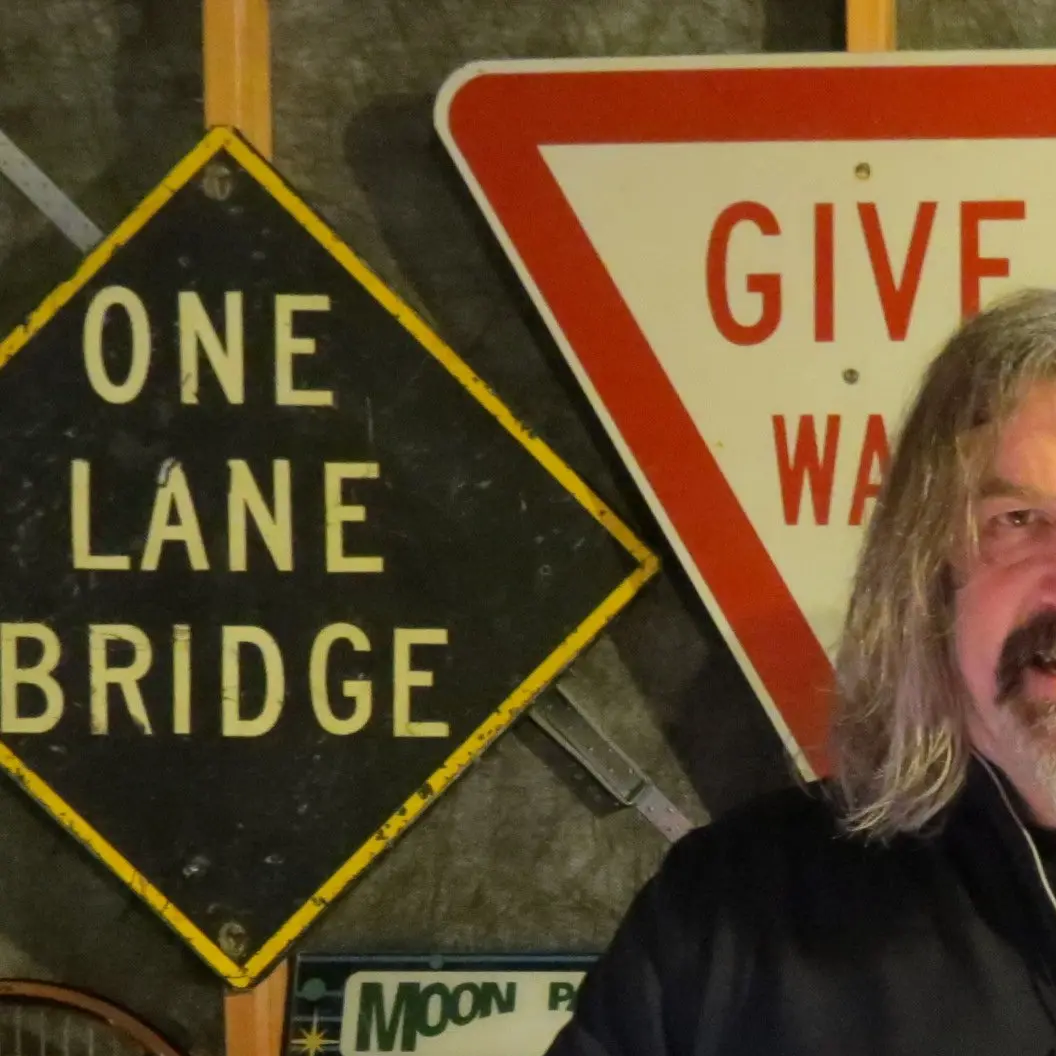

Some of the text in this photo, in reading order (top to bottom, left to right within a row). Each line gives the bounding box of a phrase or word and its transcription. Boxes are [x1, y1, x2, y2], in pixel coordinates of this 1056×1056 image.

[706, 200, 1026, 346] GIVE
[83, 285, 333, 405] ONE
[71, 458, 384, 572] LANE
[772, 414, 893, 526] WA
[0, 622, 450, 737] BRIDGE
[355, 981, 578, 1052] MOON P
